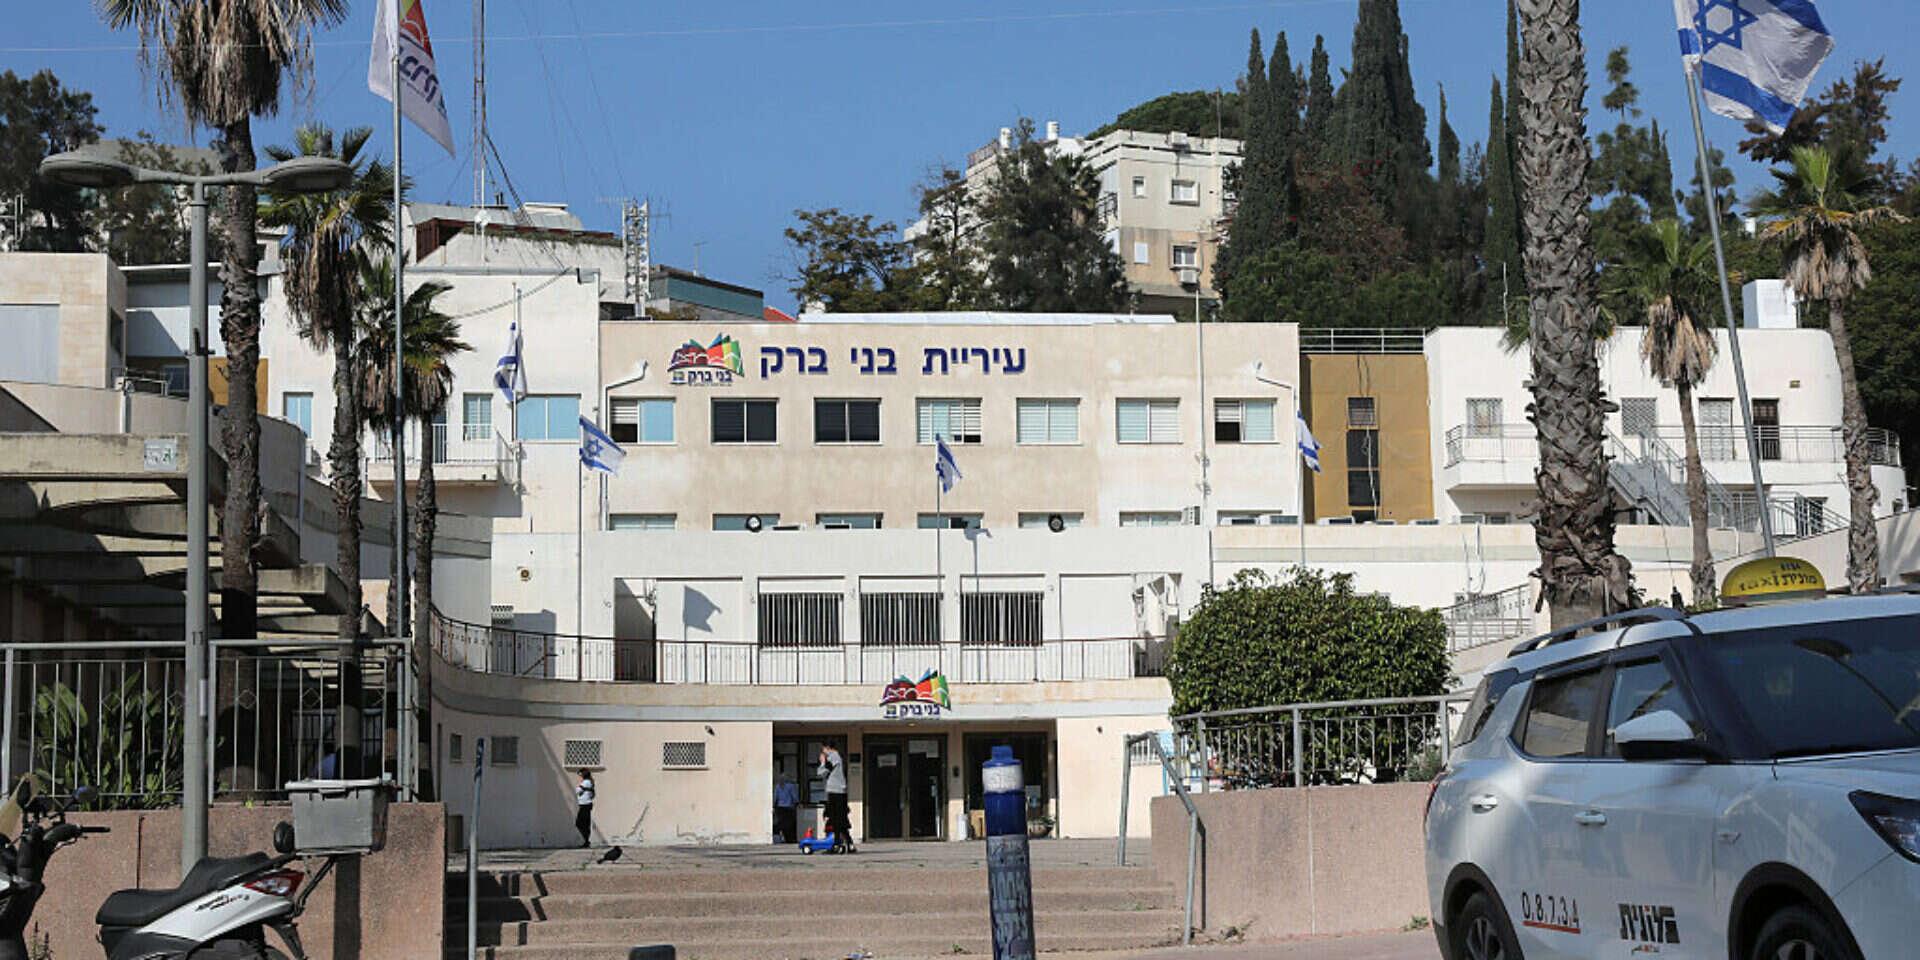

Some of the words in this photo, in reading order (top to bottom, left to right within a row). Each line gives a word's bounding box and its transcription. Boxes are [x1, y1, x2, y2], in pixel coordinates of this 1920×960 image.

[760, 346, 828, 379] ברק
[851, 347, 897, 375] בני
[922, 347, 1026, 376] עיריית
[688, 371, 712, 386] ברק
[716, 369, 733, 382] בני
[1781, 573, 1818, 586] מונית
[900, 704, 922, 717] ברק
[924, 703, 941, 715] בני
